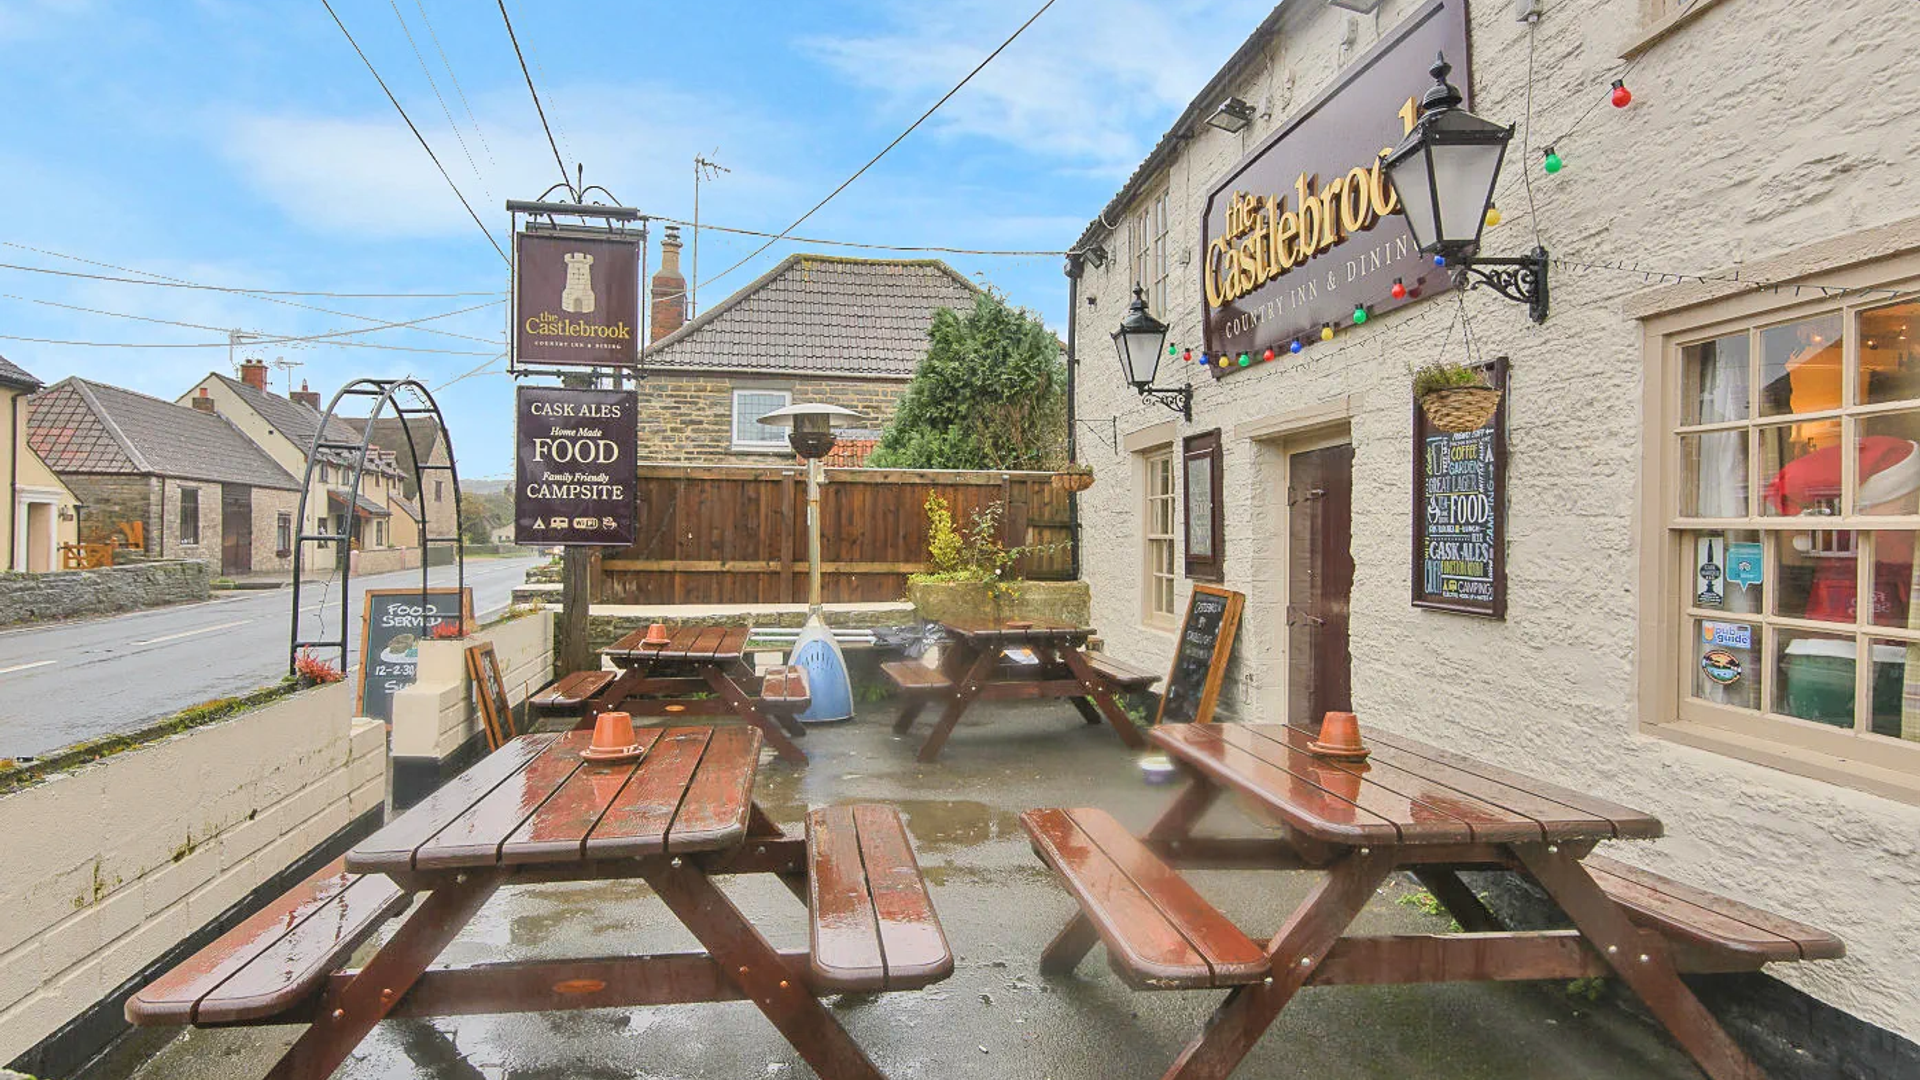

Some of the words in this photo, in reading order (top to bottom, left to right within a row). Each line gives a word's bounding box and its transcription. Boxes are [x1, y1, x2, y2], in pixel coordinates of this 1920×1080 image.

[1204, 97, 1417, 308] Castlebroo
[1225, 190, 1257, 240] the
[1226, 295, 1283, 338] COUNTRY
[1291, 279, 1318, 308] INN
[1327, 270, 1337, 291] &
[1346, 235, 1419, 284] DININ
[540, 311, 559, 322] the
[525, 317, 630, 339] Castlebrook
[531, 402, 575, 416] CASK
[579, 404, 621, 418] ALES
[550, 426, 576, 436] Home
[577, 427, 603, 437] Made
[532, 438, 619, 463] FOOD
[1450, 443, 1478, 461] COFFEE
[1449, 460, 1480, 475] GARDEN
[542, 471, 574, 483] Family
[574, 472, 610, 484] Friendly
[1428, 475, 1451, 493] GREAT
[527, 483, 624, 500] CAMPSITE
[1450, 494, 1488, 523] FOOD
[1429, 541, 1460, 560] CASK
[1460, 542, 1489, 562] ALES
[1458, 581, 1493, 595] CAMPING
[387, 603, 437, 616] FOOD
[1714, 626, 1736, 638] pub
[1716, 634, 1749, 645] guide
